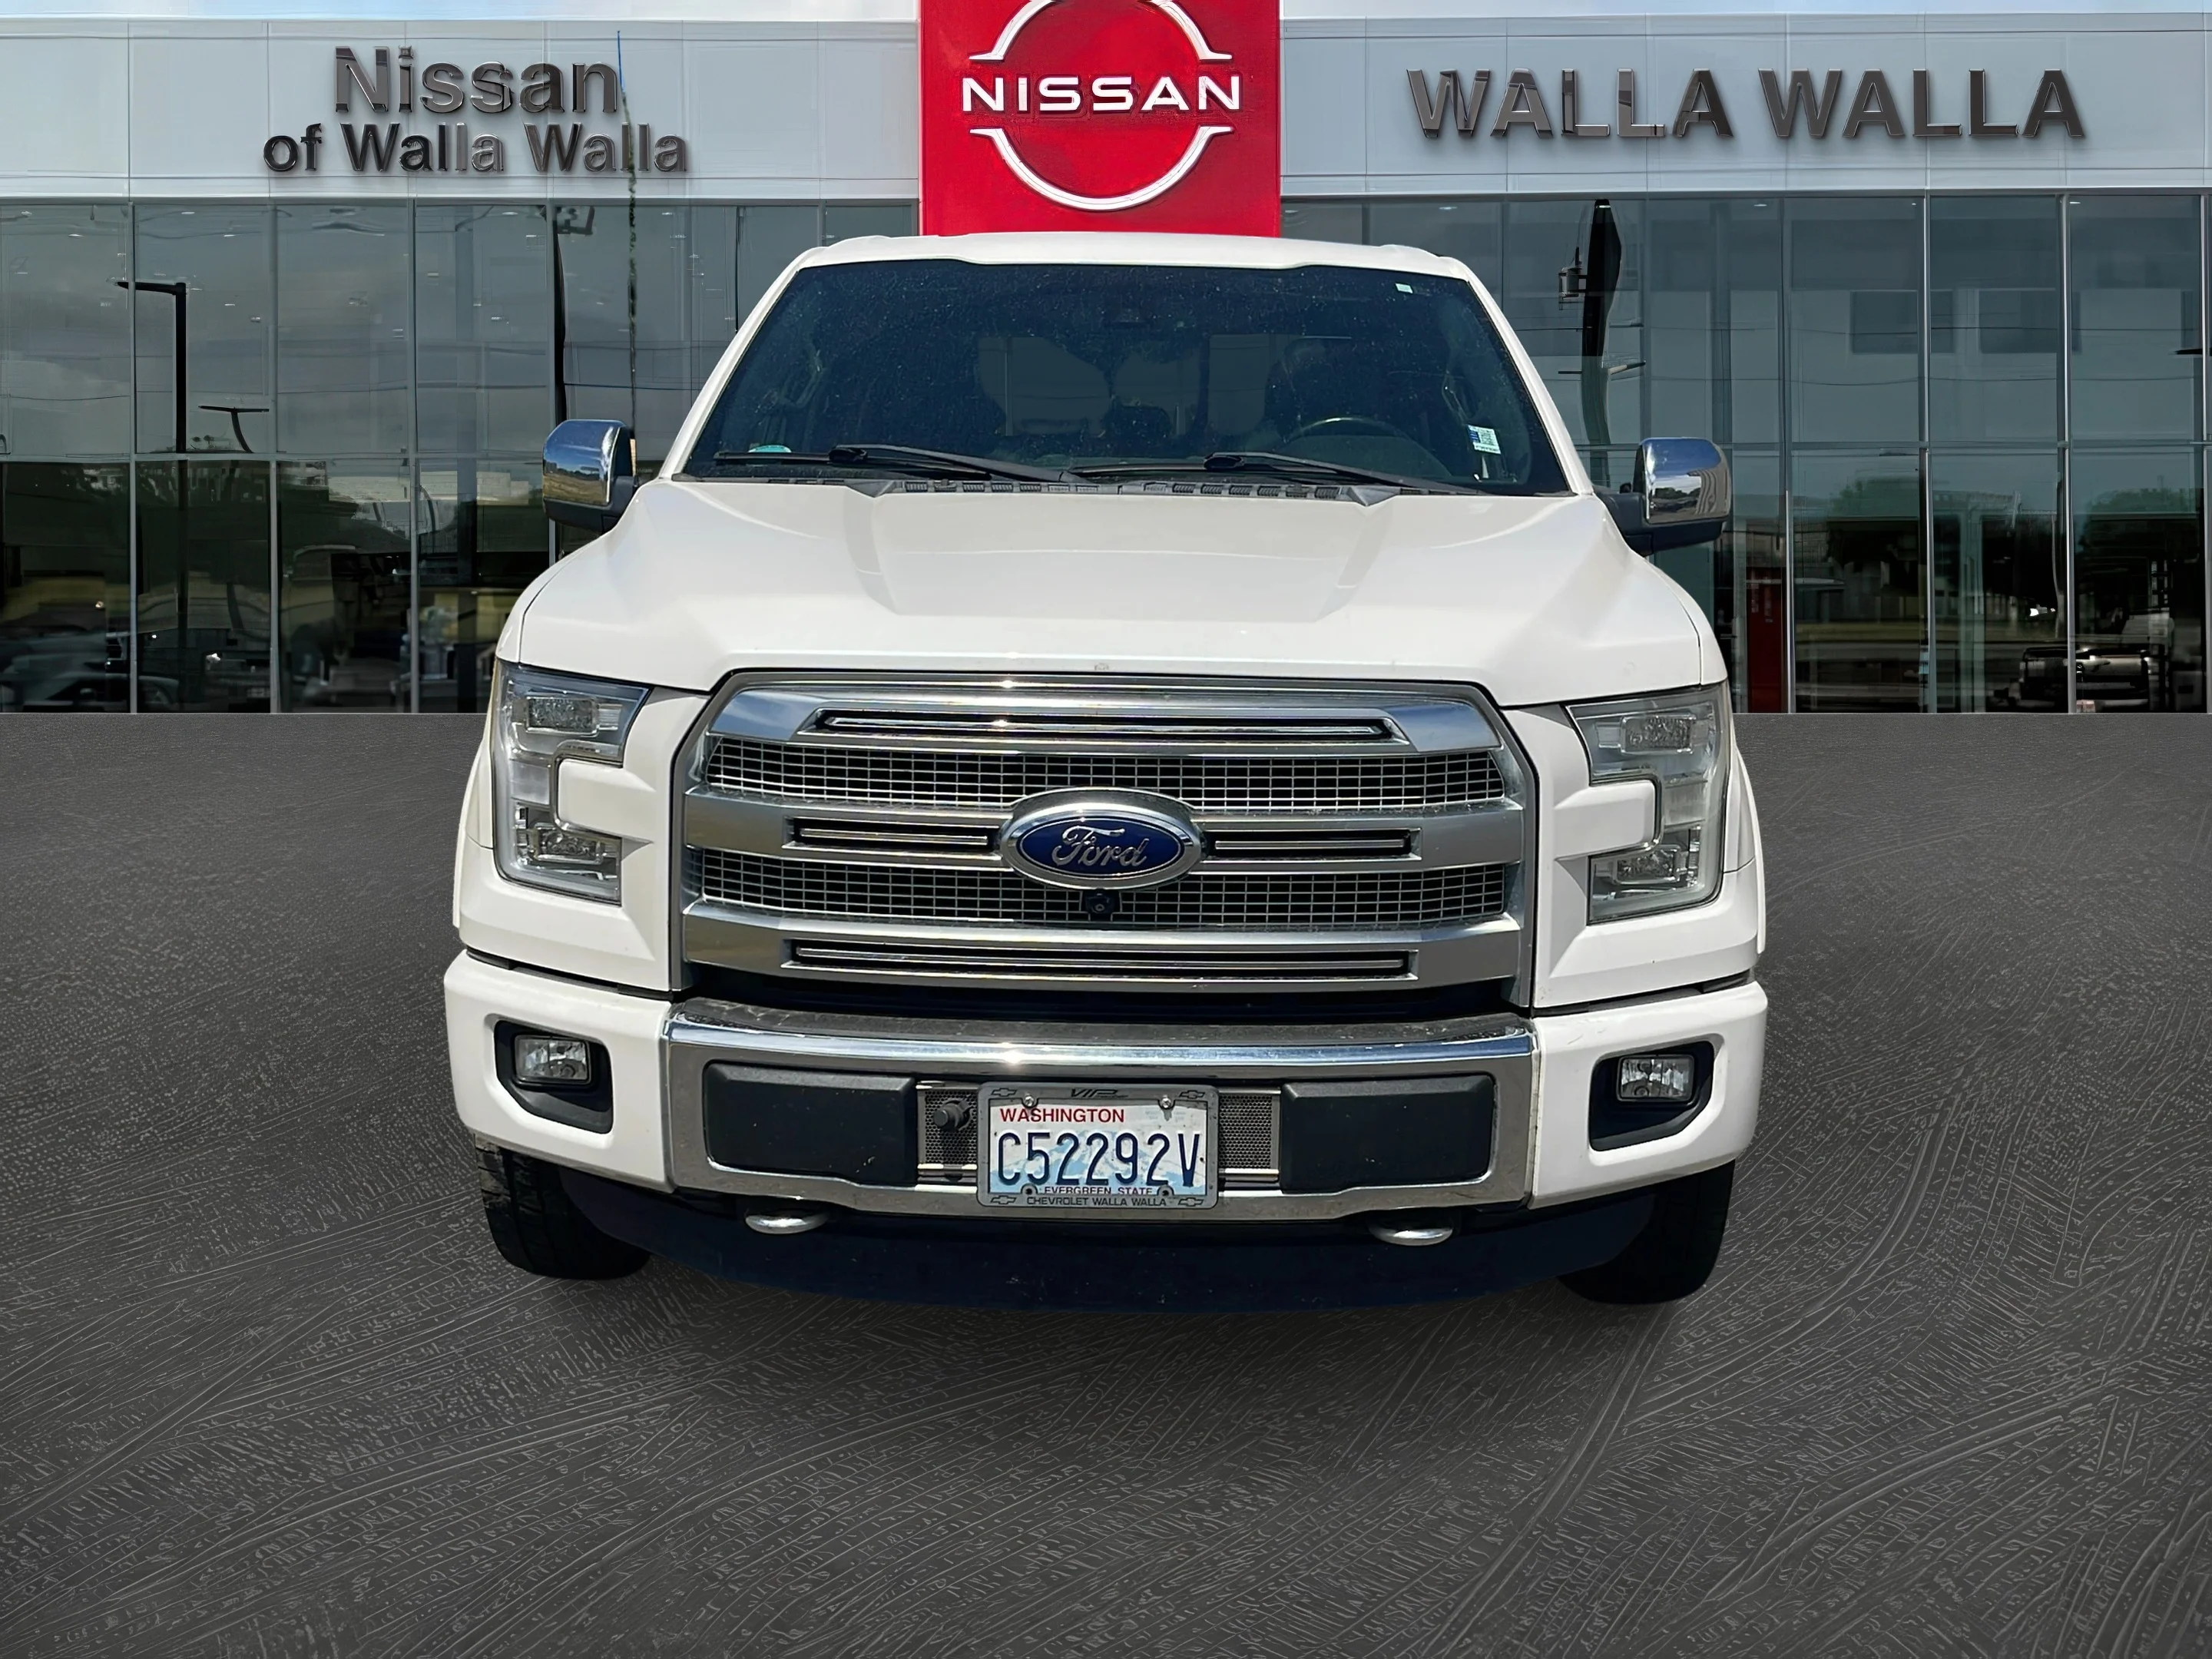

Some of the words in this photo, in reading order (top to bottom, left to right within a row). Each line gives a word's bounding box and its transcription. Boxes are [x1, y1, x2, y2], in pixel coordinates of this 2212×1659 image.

[334, 45, 618, 114] Nissan
[962, 75, 1240, 112] NISSAN
[1406, 68, 1734, 139] WALLA
[1757, 68, 2085, 139] WALLA
[263, 122, 324, 172] of
[339, 121, 505, 172] Walla
[523, 121, 687, 172] Walla
[1051, 825, 1150, 867] Ford
[999, 1108, 1125, 1123] WASHINGTON
[998, 1131, 1200, 1187] C52292V
[1026, 1196, 1089, 1205] CHEVROLET
[1091, 1197, 1128, 1207] WALLA
[1131, 1197, 1167, 1207] WALLA
[1044, 1186, 1112, 1195] EVERGREEN
[1118, 1187, 1153, 1196] STATE
